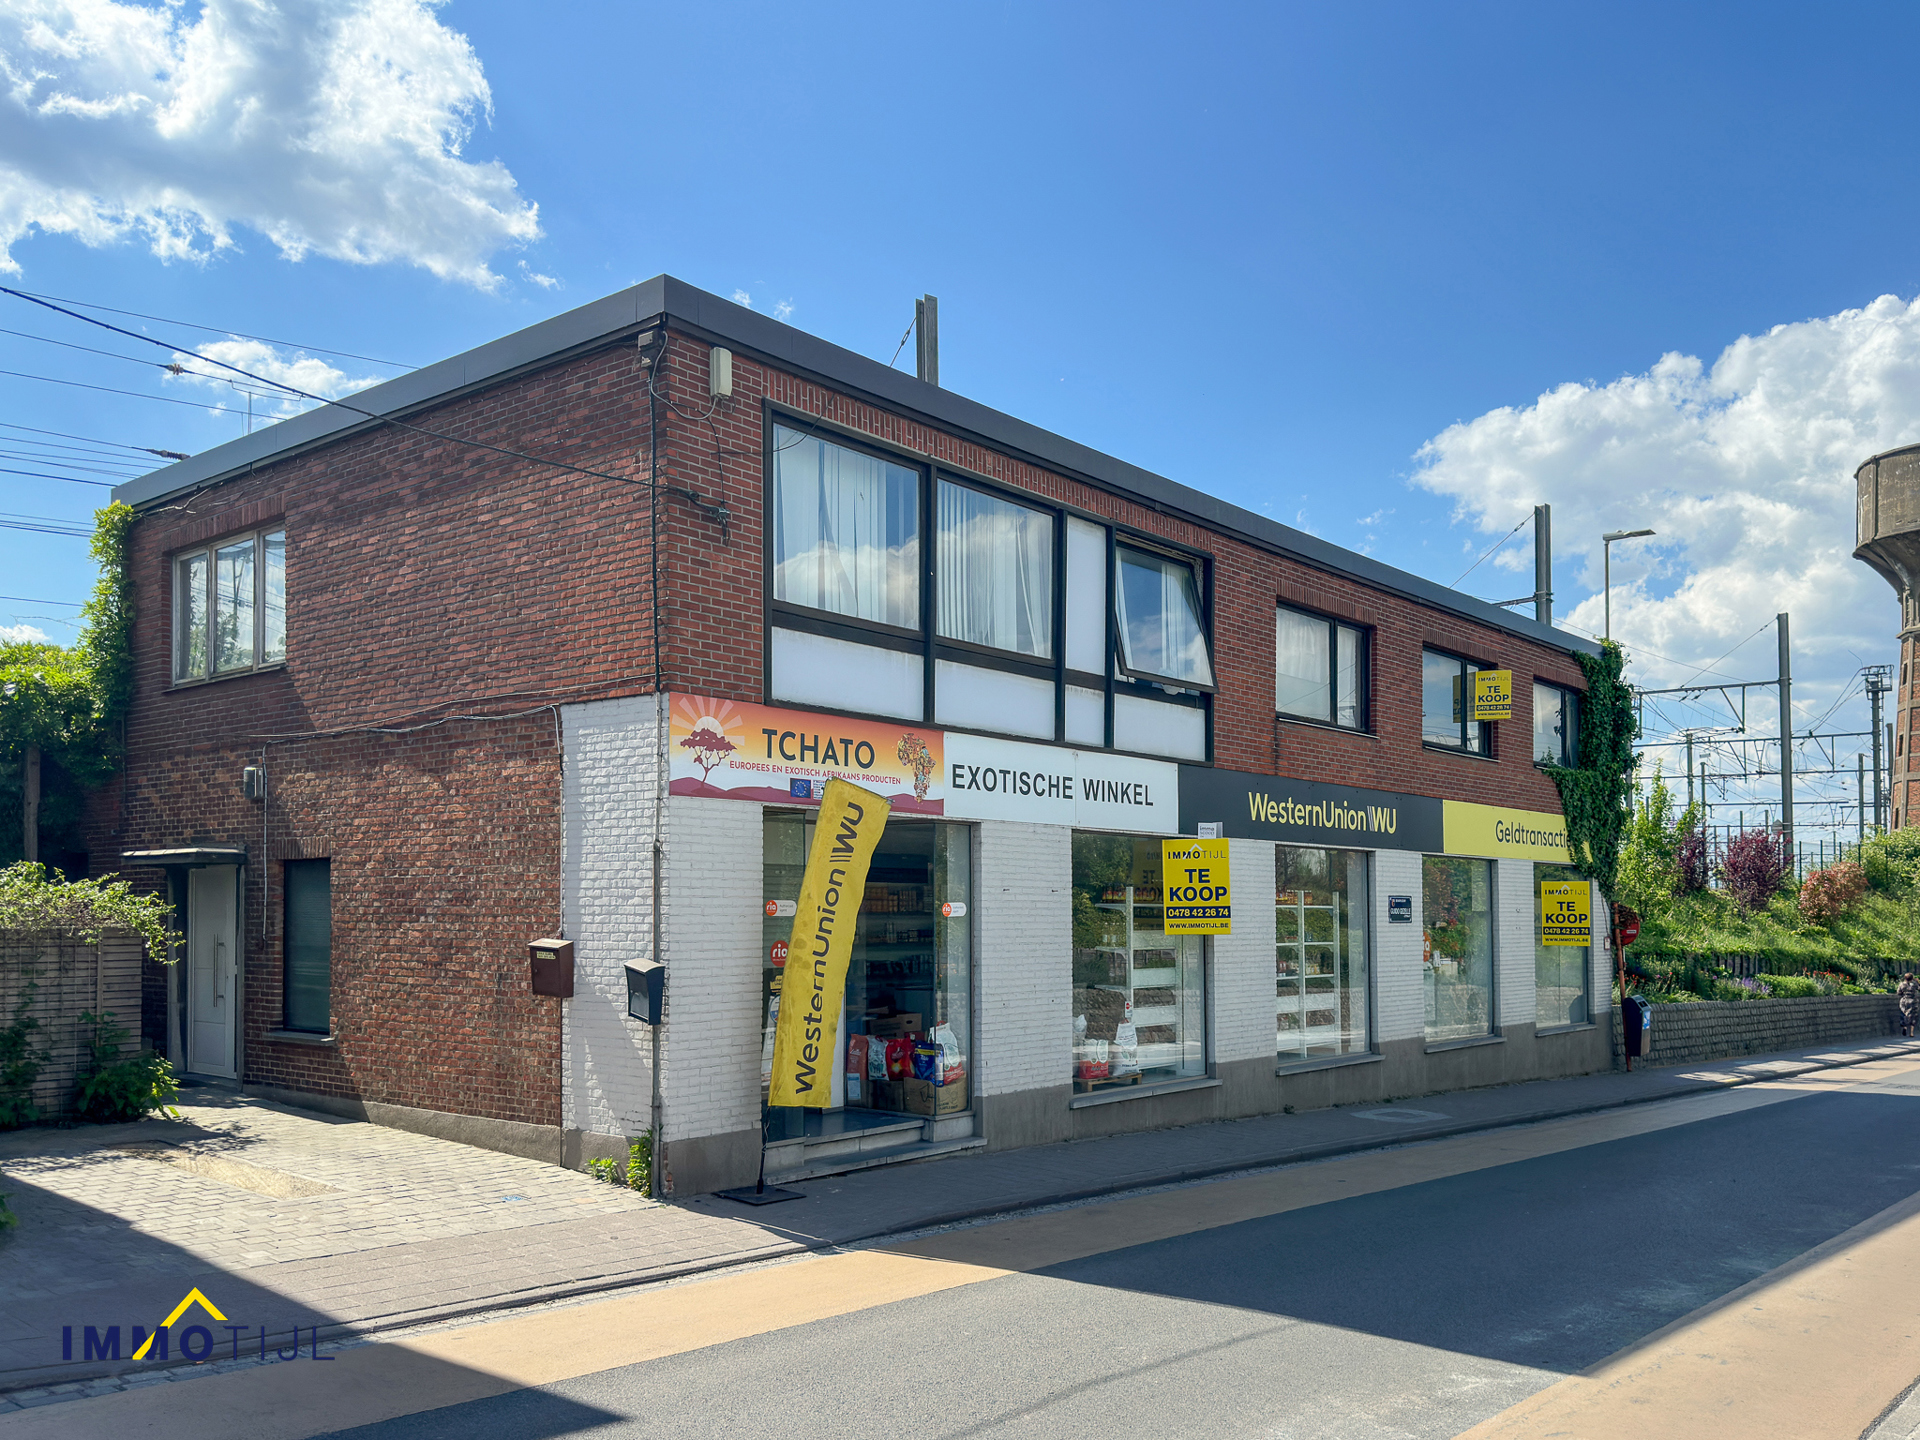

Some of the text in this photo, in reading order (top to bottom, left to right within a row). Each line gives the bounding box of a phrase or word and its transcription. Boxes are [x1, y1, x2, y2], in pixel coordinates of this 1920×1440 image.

[1478, 694, 1509, 702] KOOP
[762, 728, 875, 769] TCHATO
[729, 761, 901, 785] EUROPEES EN EXOTISCH AFRIKAANS PRODUCTEN
[952, 763, 1154, 806] EXOTISCHE WINKEL
[1248, 791, 1367, 832] WesternUnion
[1168, 850, 1226, 859] IMMOTIJL
[1184, 869, 1211, 884] TE
[1169, 886, 1228, 902] KOOP
[767, 902, 776, 910] ria
[1168, 908, 1190, 917] 0478
[1192, 909, 1203, 917] 42
[1205, 908, 1216, 917] 26
[1218, 908, 1229, 916] 74
[1557, 902, 1576, 912] TE
[1545, 913, 1588, 924] KOOP
[795, 868, 846, 1094] WesternUnion
